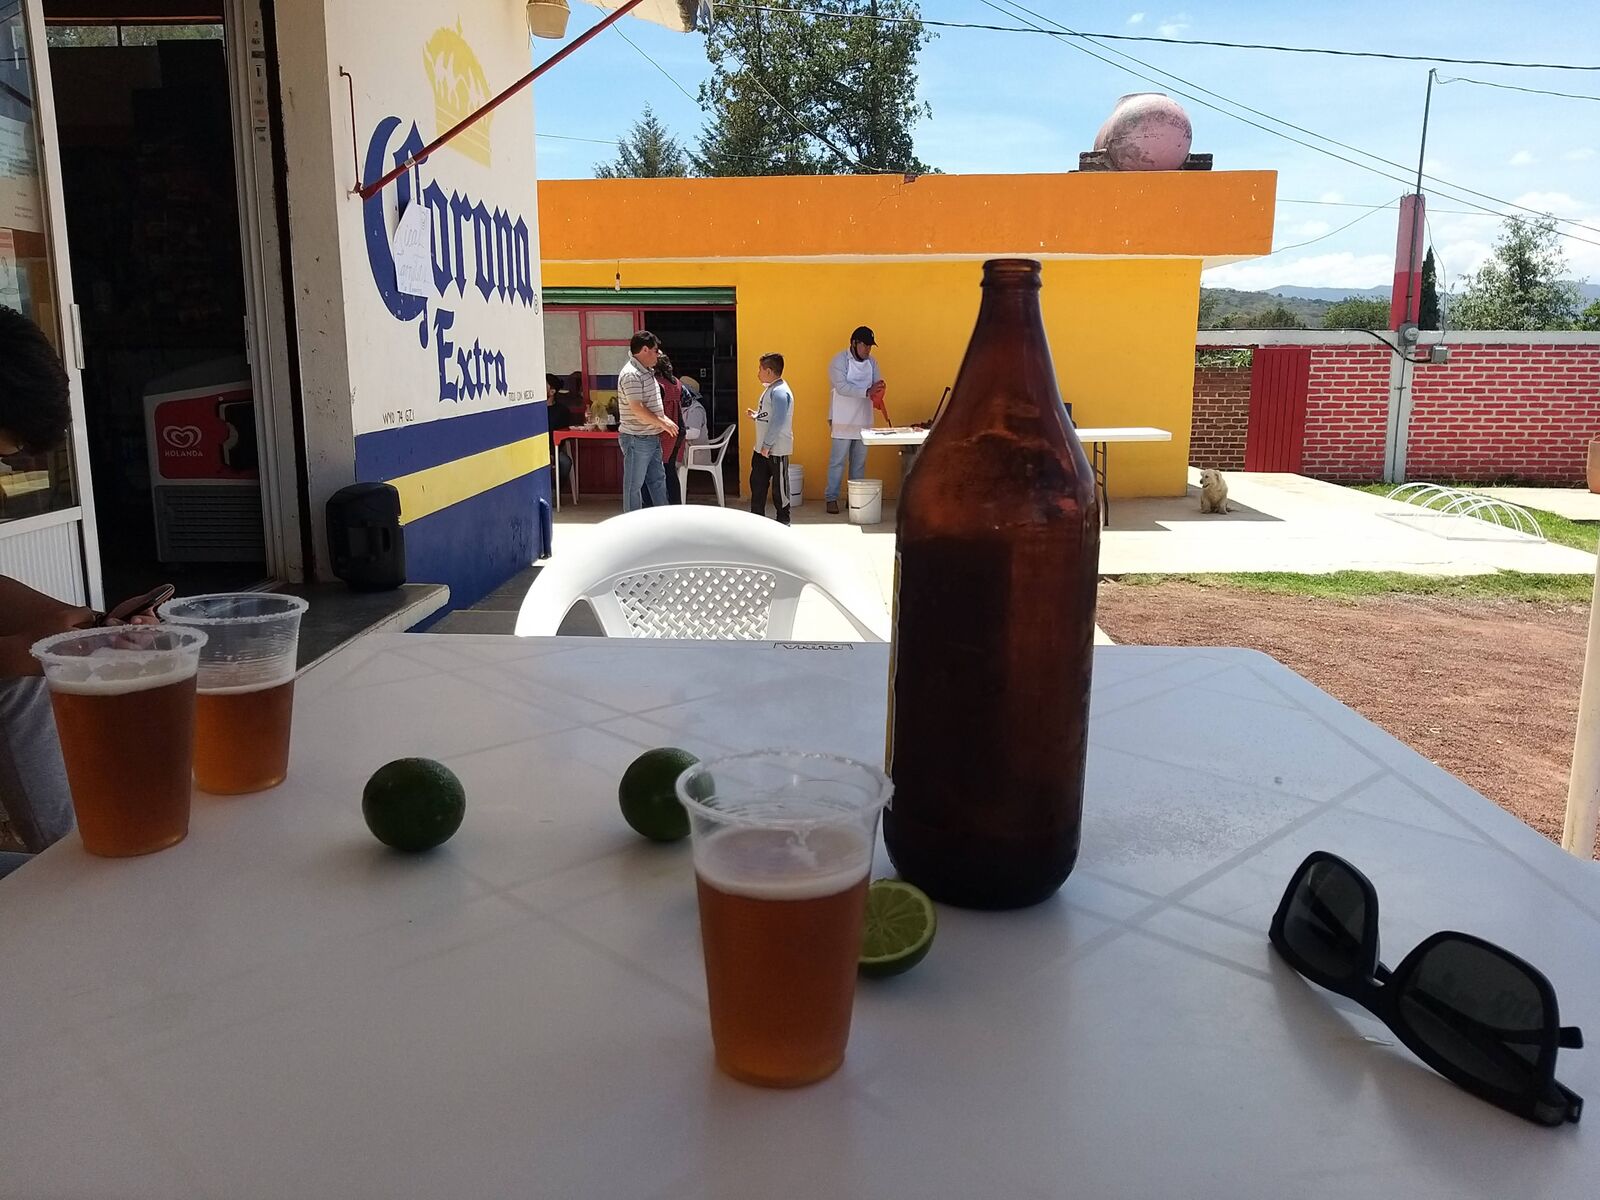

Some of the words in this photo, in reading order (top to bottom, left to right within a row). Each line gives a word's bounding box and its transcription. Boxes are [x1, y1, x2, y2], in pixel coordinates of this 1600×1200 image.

[363, 116, 533, 349] Corona
[434, 308, 508, 403] Extra
[164, 449, 203, 457] HOLANDA
